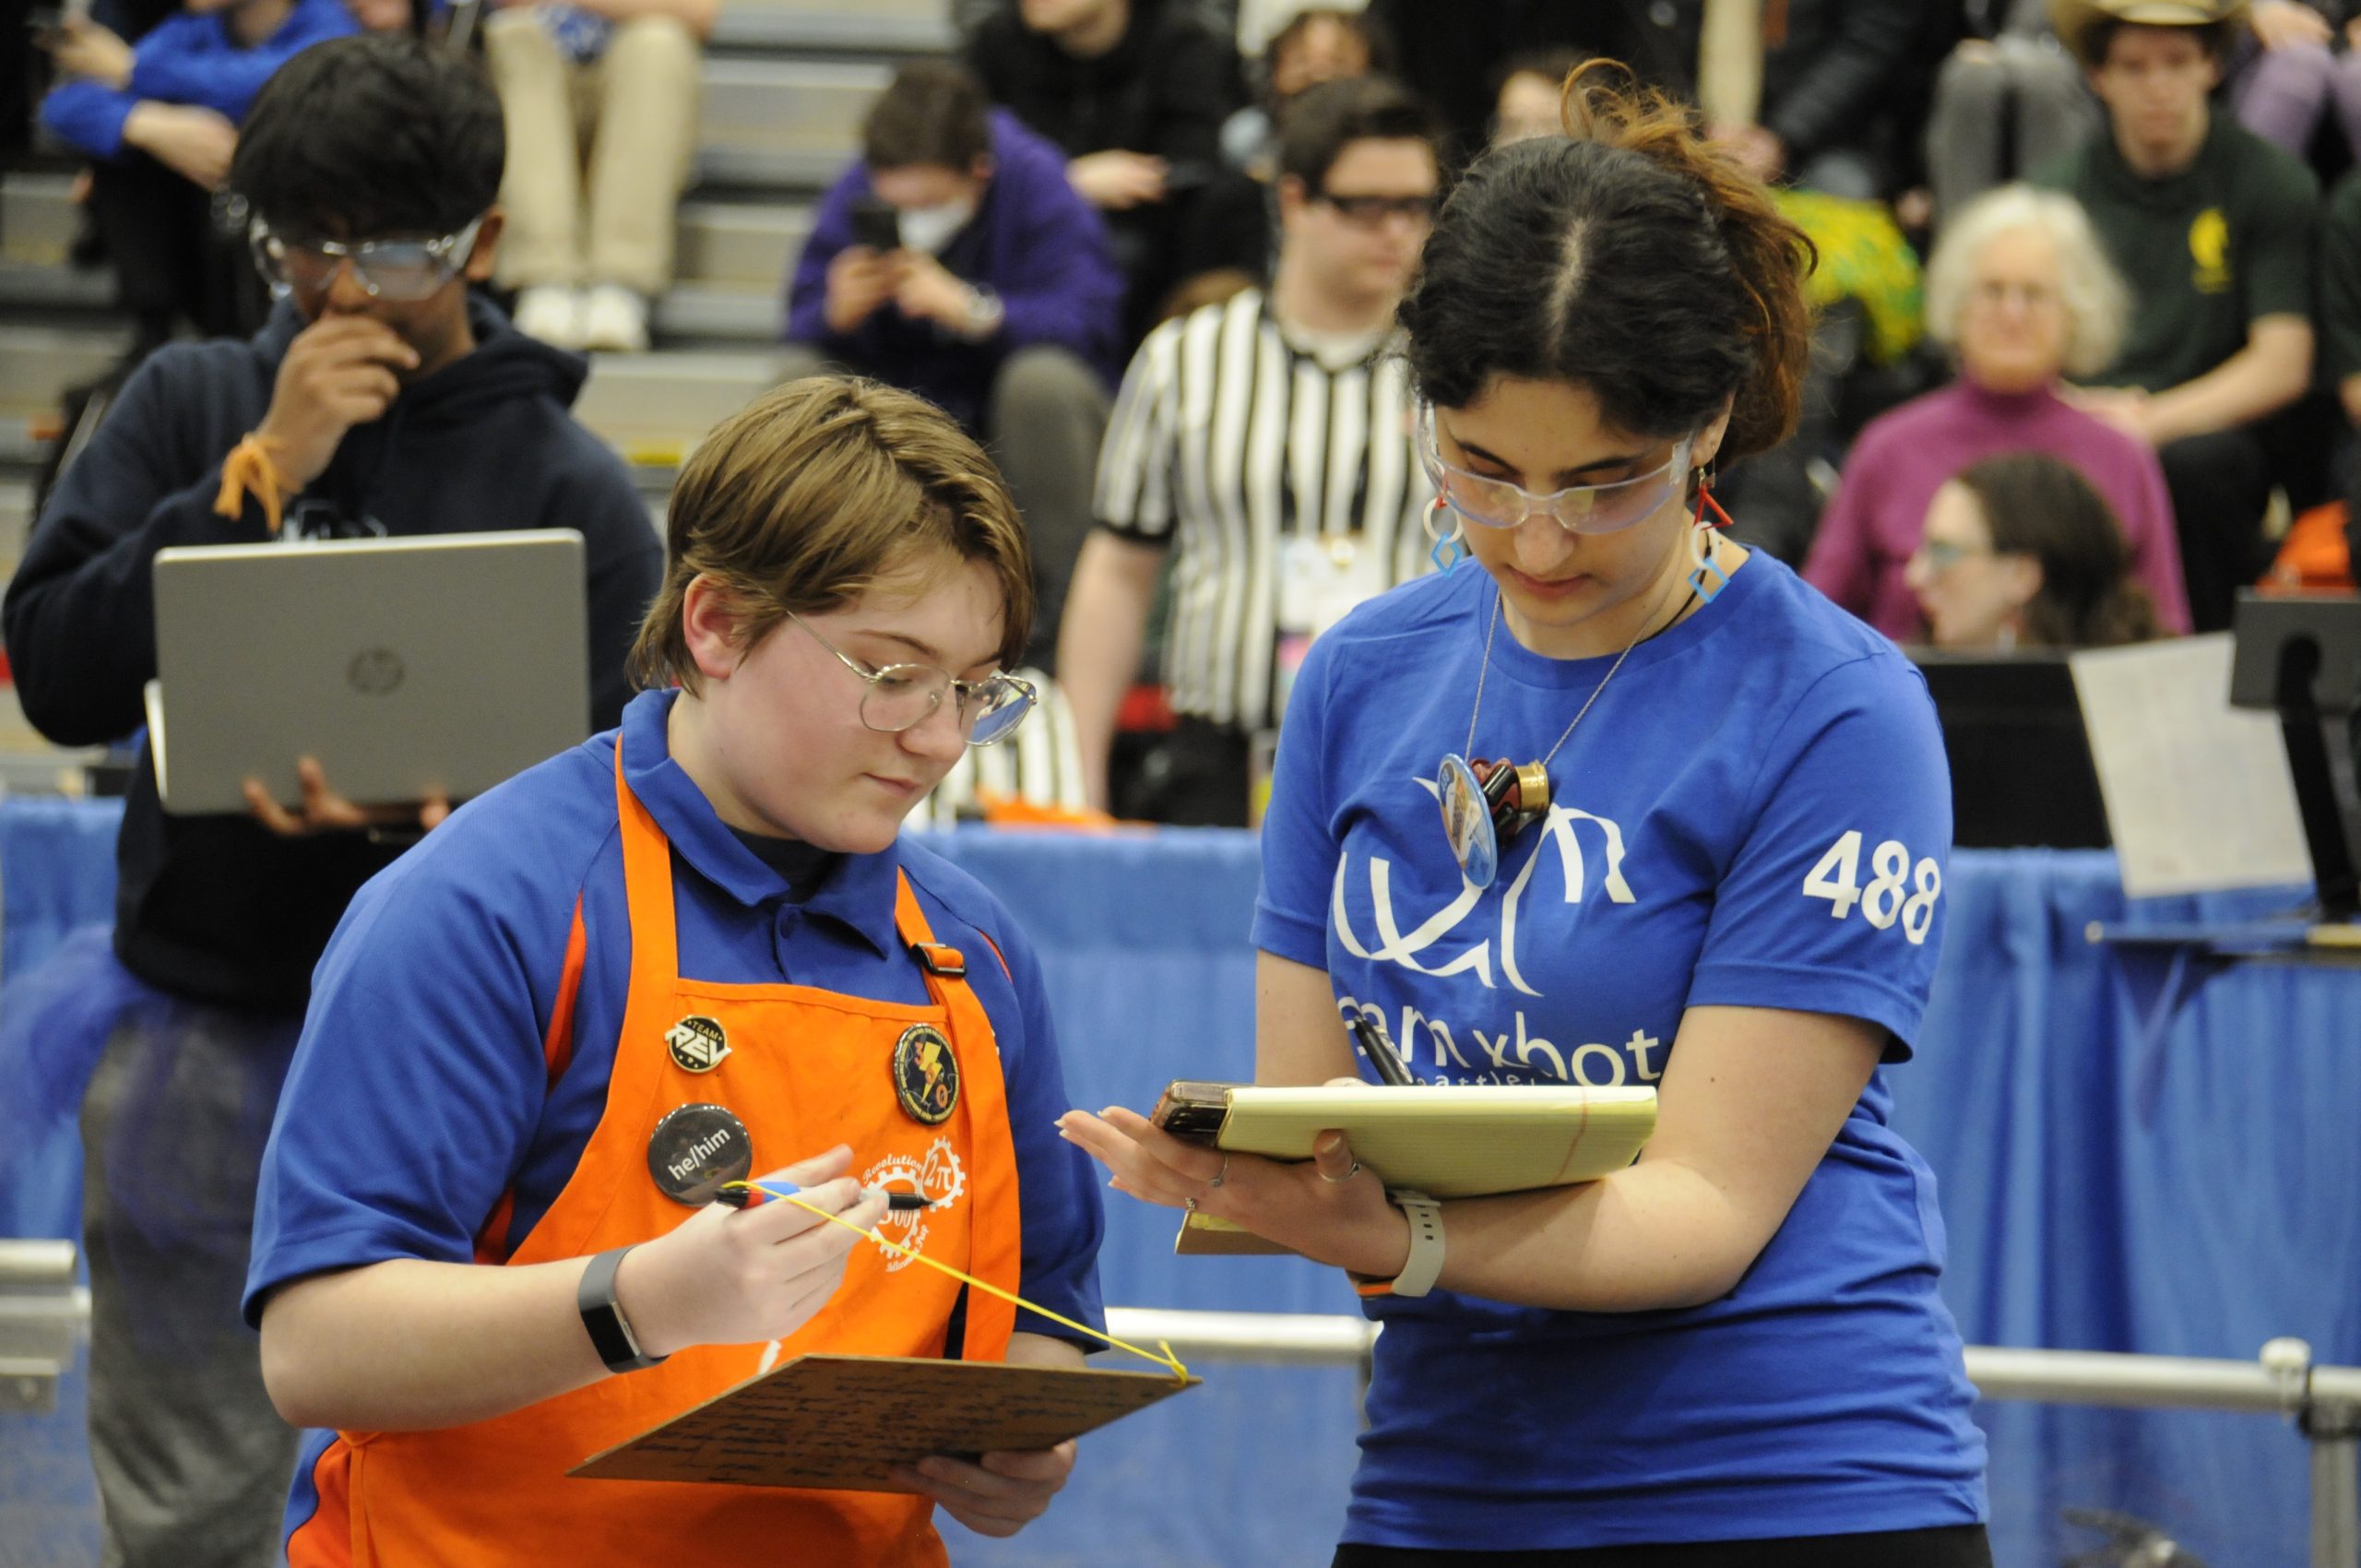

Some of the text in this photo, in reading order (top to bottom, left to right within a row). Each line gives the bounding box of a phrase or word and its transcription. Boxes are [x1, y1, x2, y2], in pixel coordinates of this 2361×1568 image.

[1802, 830, 1941, 944] 488
[664, 1024, 732, 1065] REV
[693, 1020, 718, 1040] TEAM
[668, 1127, 730, 1182] he/him
